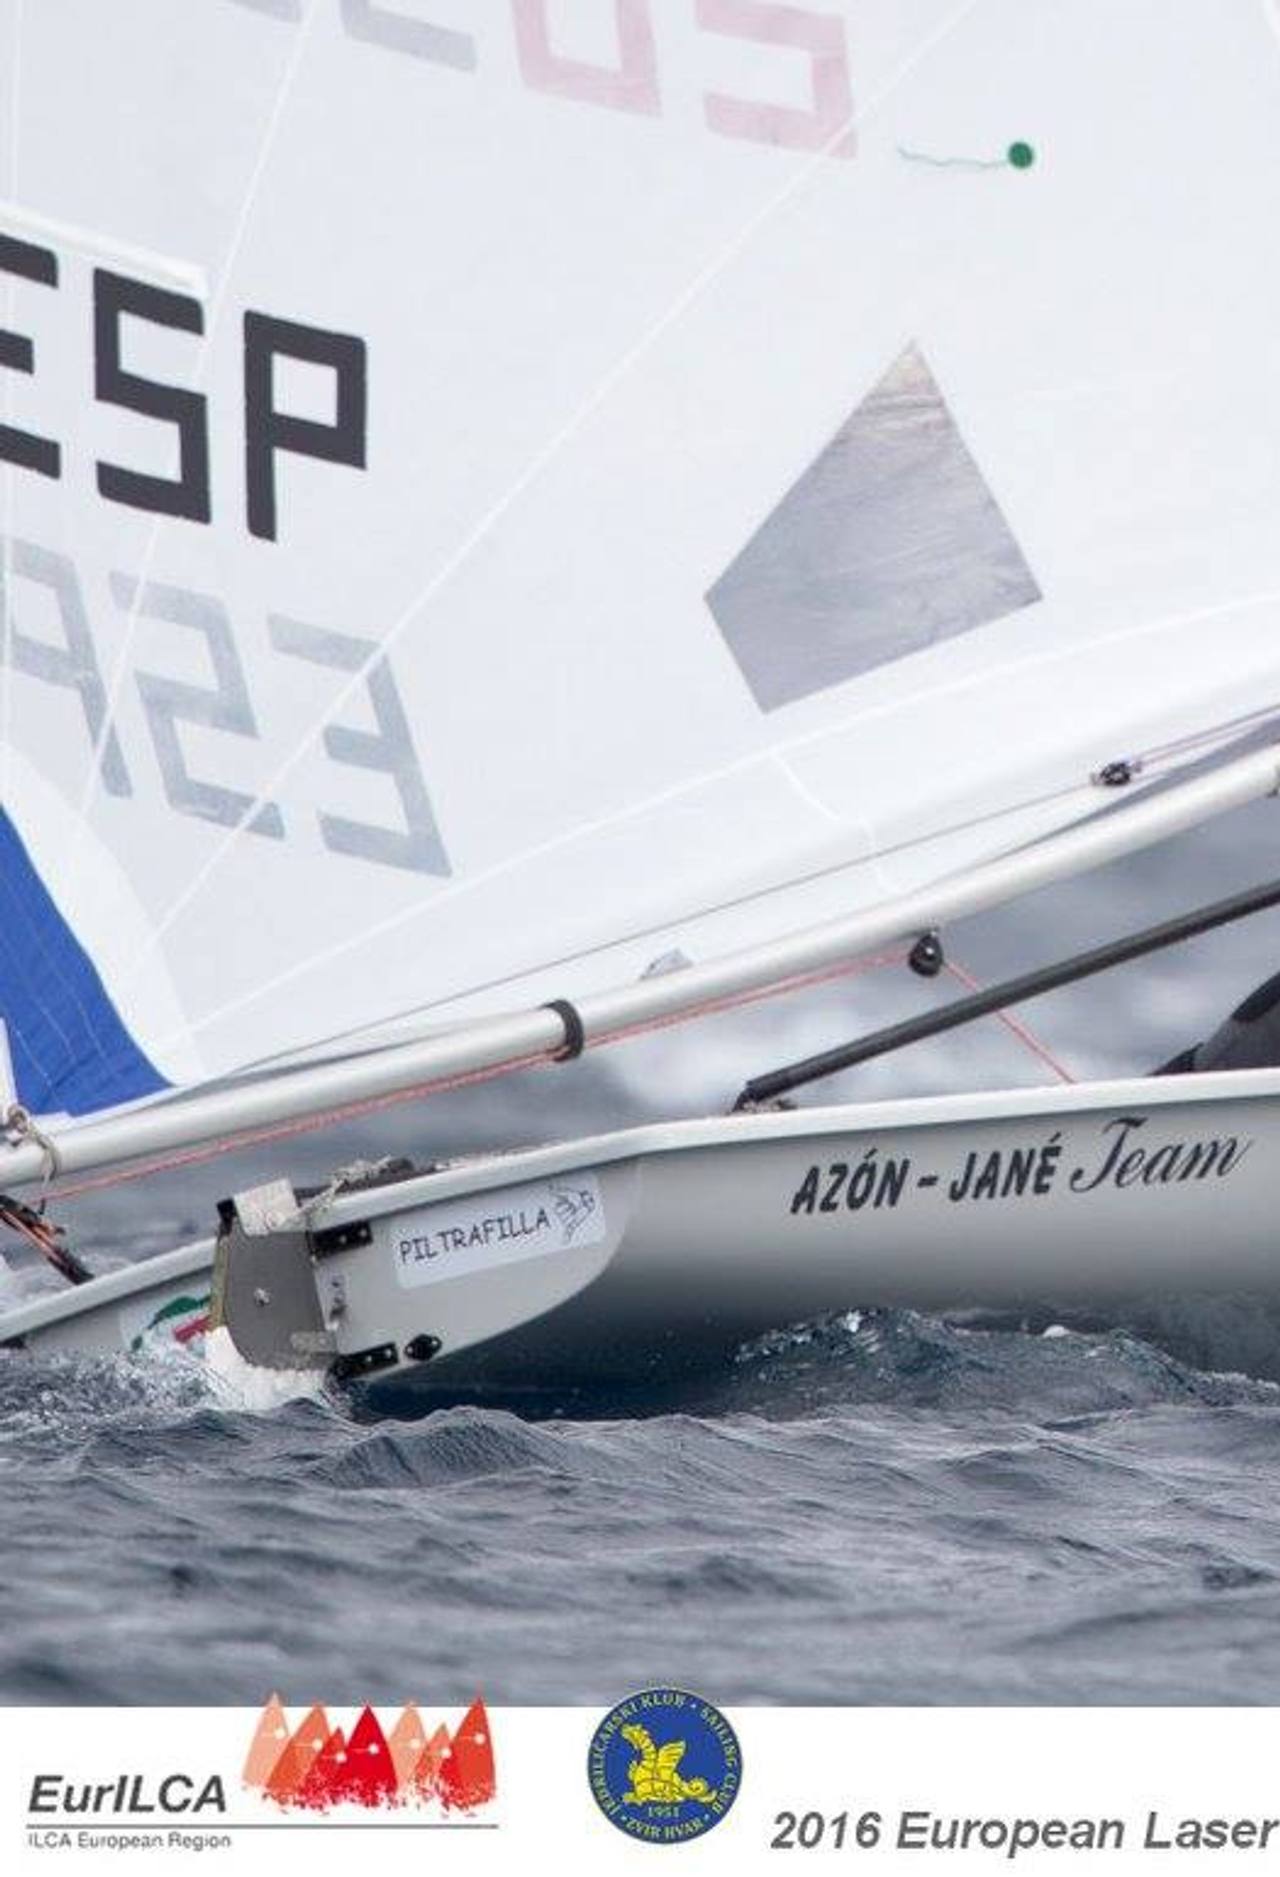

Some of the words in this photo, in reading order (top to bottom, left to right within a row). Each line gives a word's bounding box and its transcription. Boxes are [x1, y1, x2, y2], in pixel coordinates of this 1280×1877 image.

[791, 1149, 910, 1215] AZÓN
[949, 1132, 1063, 1202] JANÉ
[1071, 1116, 1254, 1194] Team
[400, 1208, 551, 1264] PILTRAFILLA
